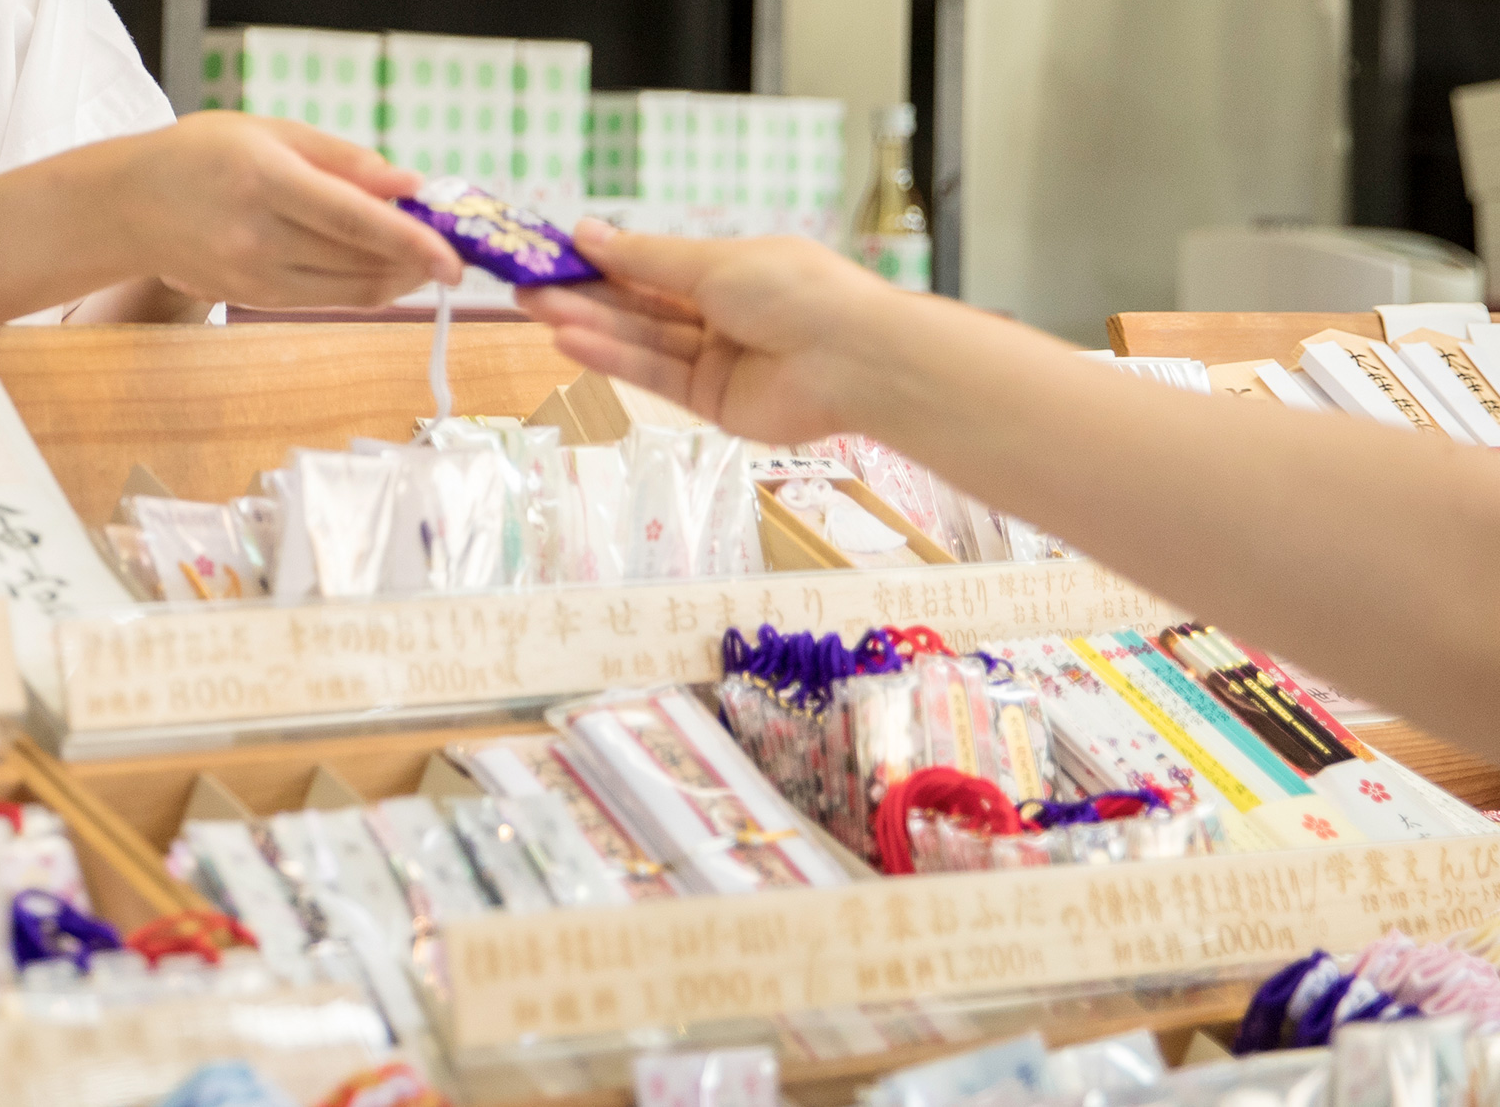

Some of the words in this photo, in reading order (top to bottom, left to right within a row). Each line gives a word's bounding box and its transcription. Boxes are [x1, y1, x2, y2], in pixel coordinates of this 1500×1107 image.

[548, 586, 826, 647] 幸せおまもり
[872, 576, 989, 624] 安産おまもり
[1012, 599, 1071, 624] おまもり
